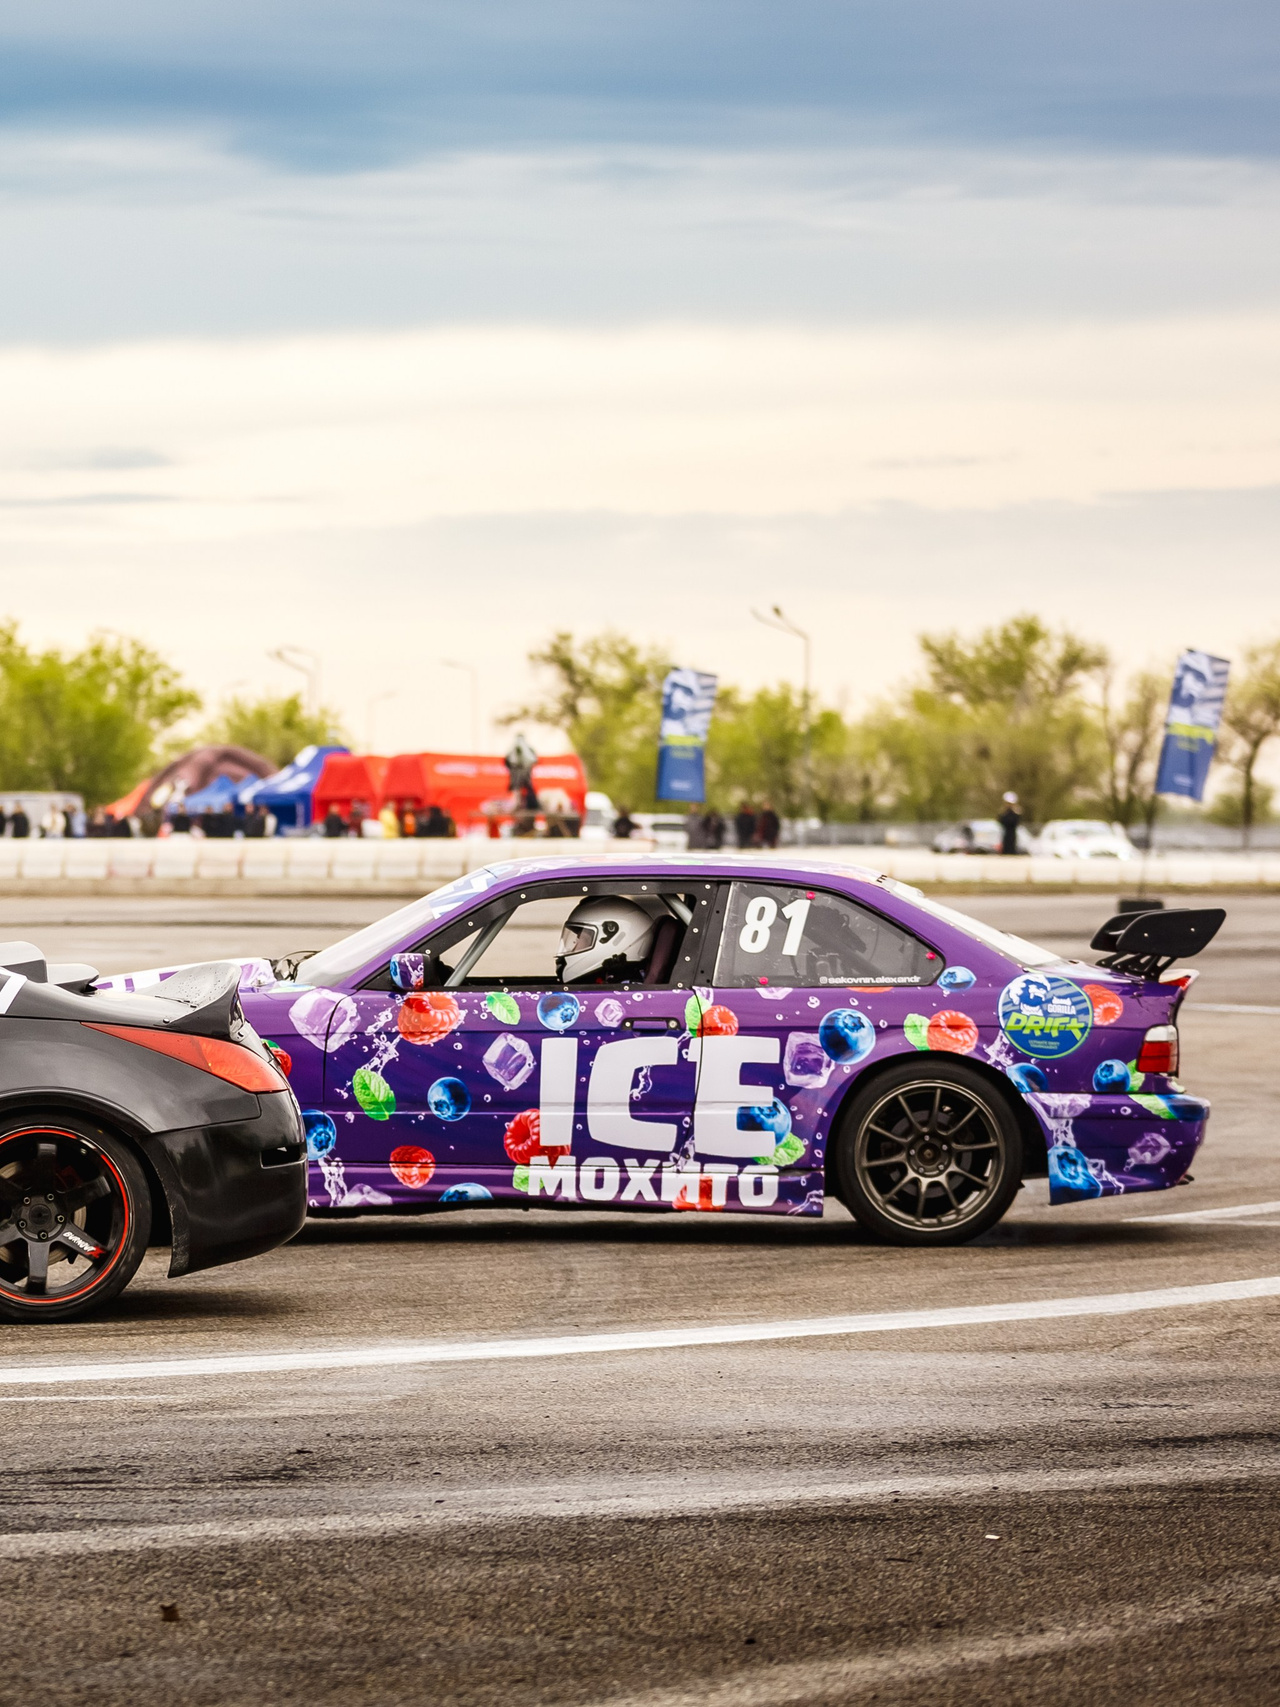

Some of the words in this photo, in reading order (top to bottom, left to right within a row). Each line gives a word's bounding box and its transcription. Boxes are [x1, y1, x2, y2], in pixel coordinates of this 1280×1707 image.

[738, 896, 811, 957] 81
[1005, 1012, 1085, 1041] DRIFT
[1047, 1004, 1077, 1015] GORILLA
[539, 1035, 781, 1158] ICE
